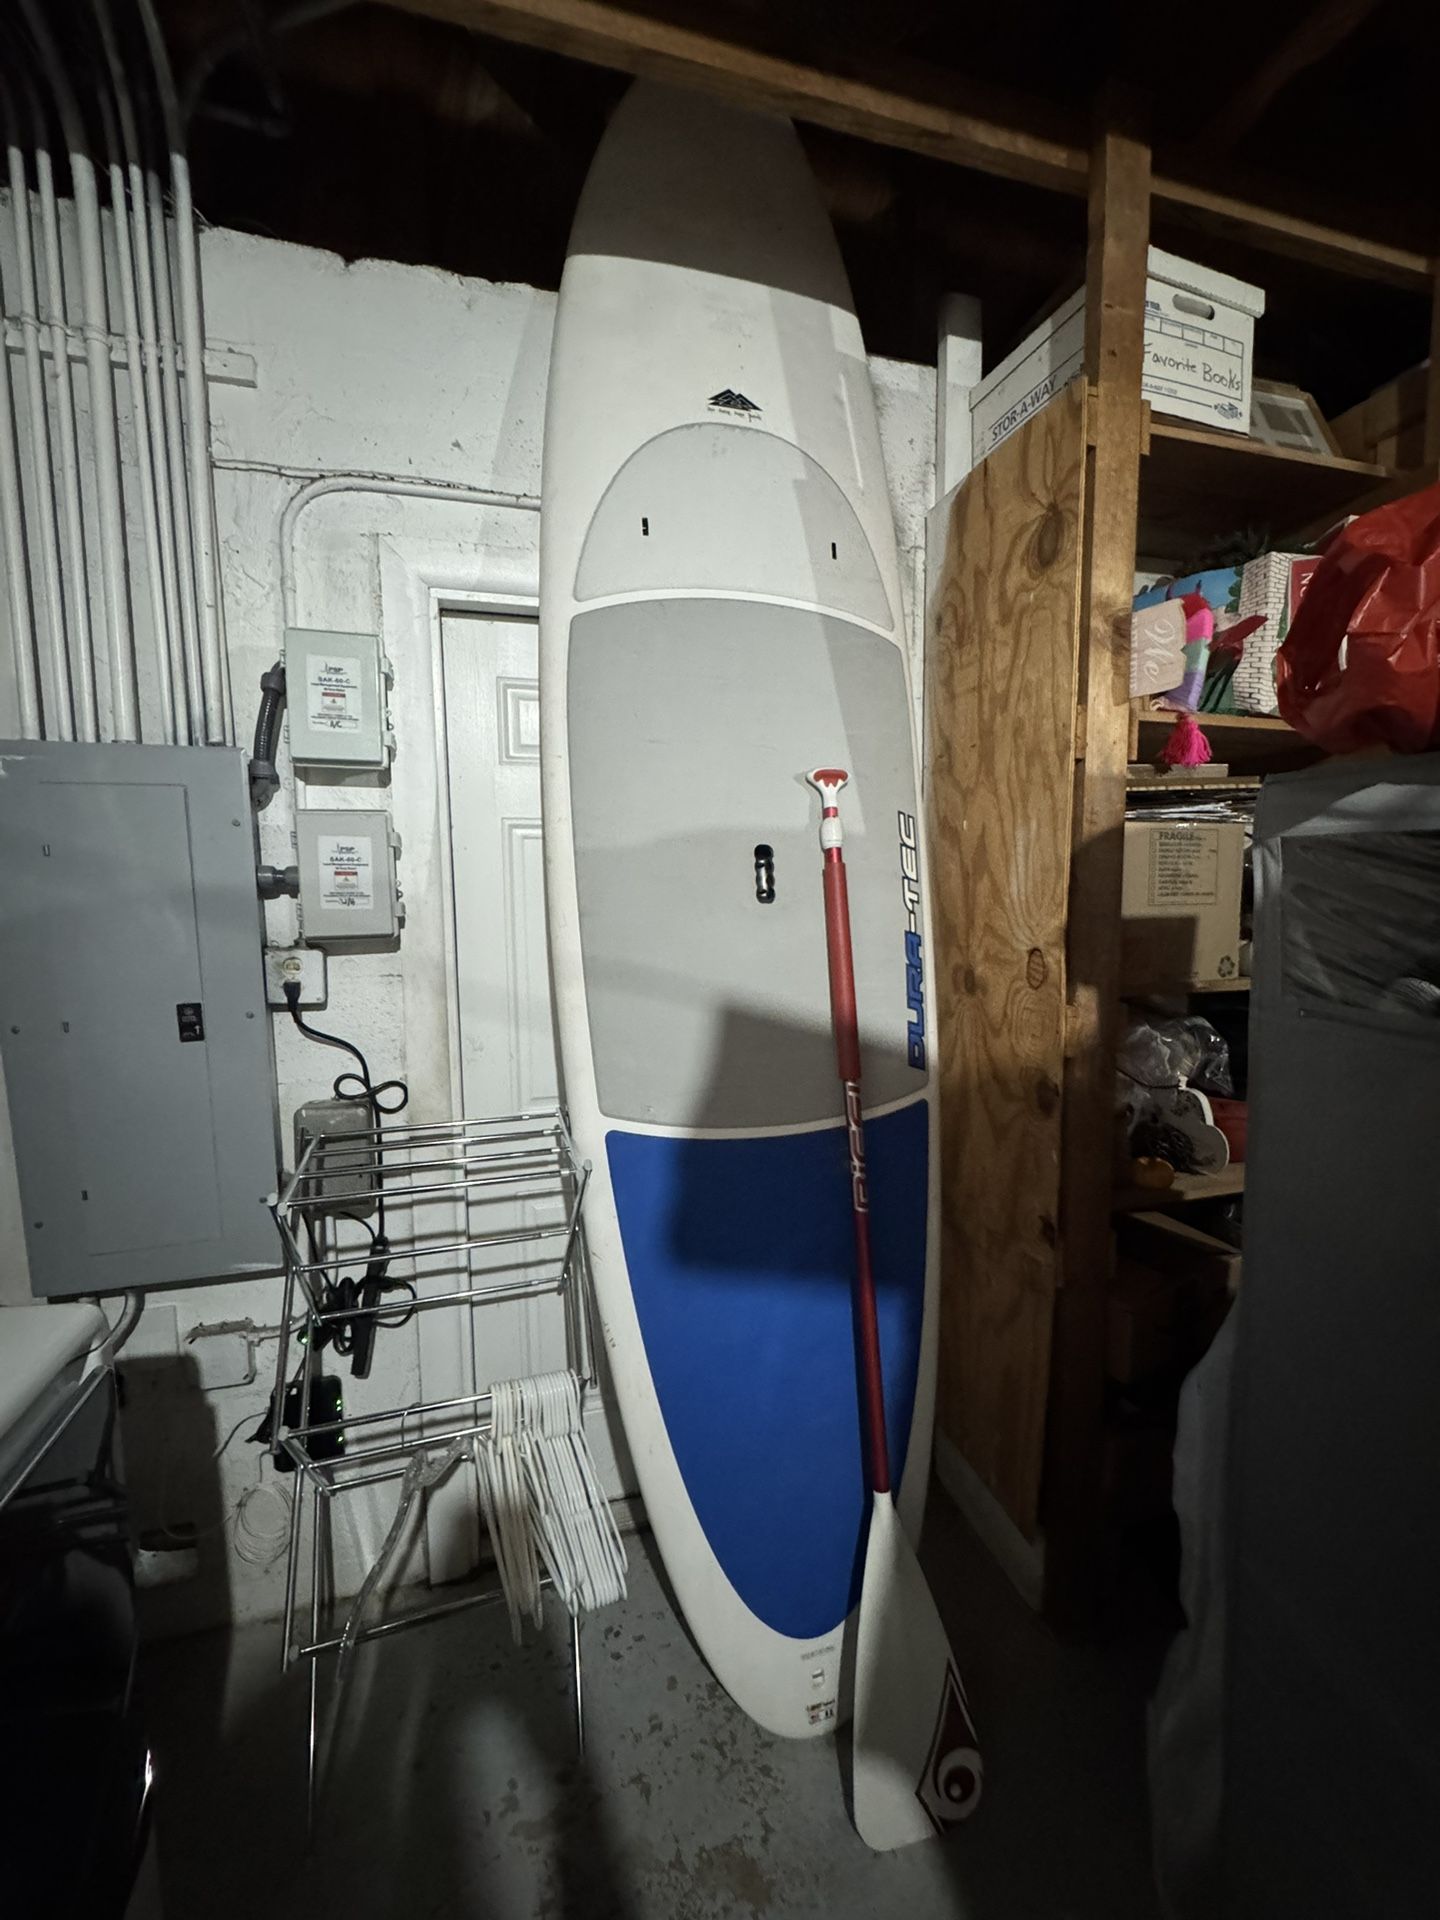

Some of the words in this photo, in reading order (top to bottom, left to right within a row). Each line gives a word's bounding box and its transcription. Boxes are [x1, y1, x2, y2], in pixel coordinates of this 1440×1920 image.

[1143, 343, 1197, 373] Favorite
[1201, 362, 1241, 391] Books
[992, 374, 1057, 441] STOR-A-WAY
[1158, 831, 1195, 841] FRAGILE
[897, 810, 926, 1071] DURA-TEC
